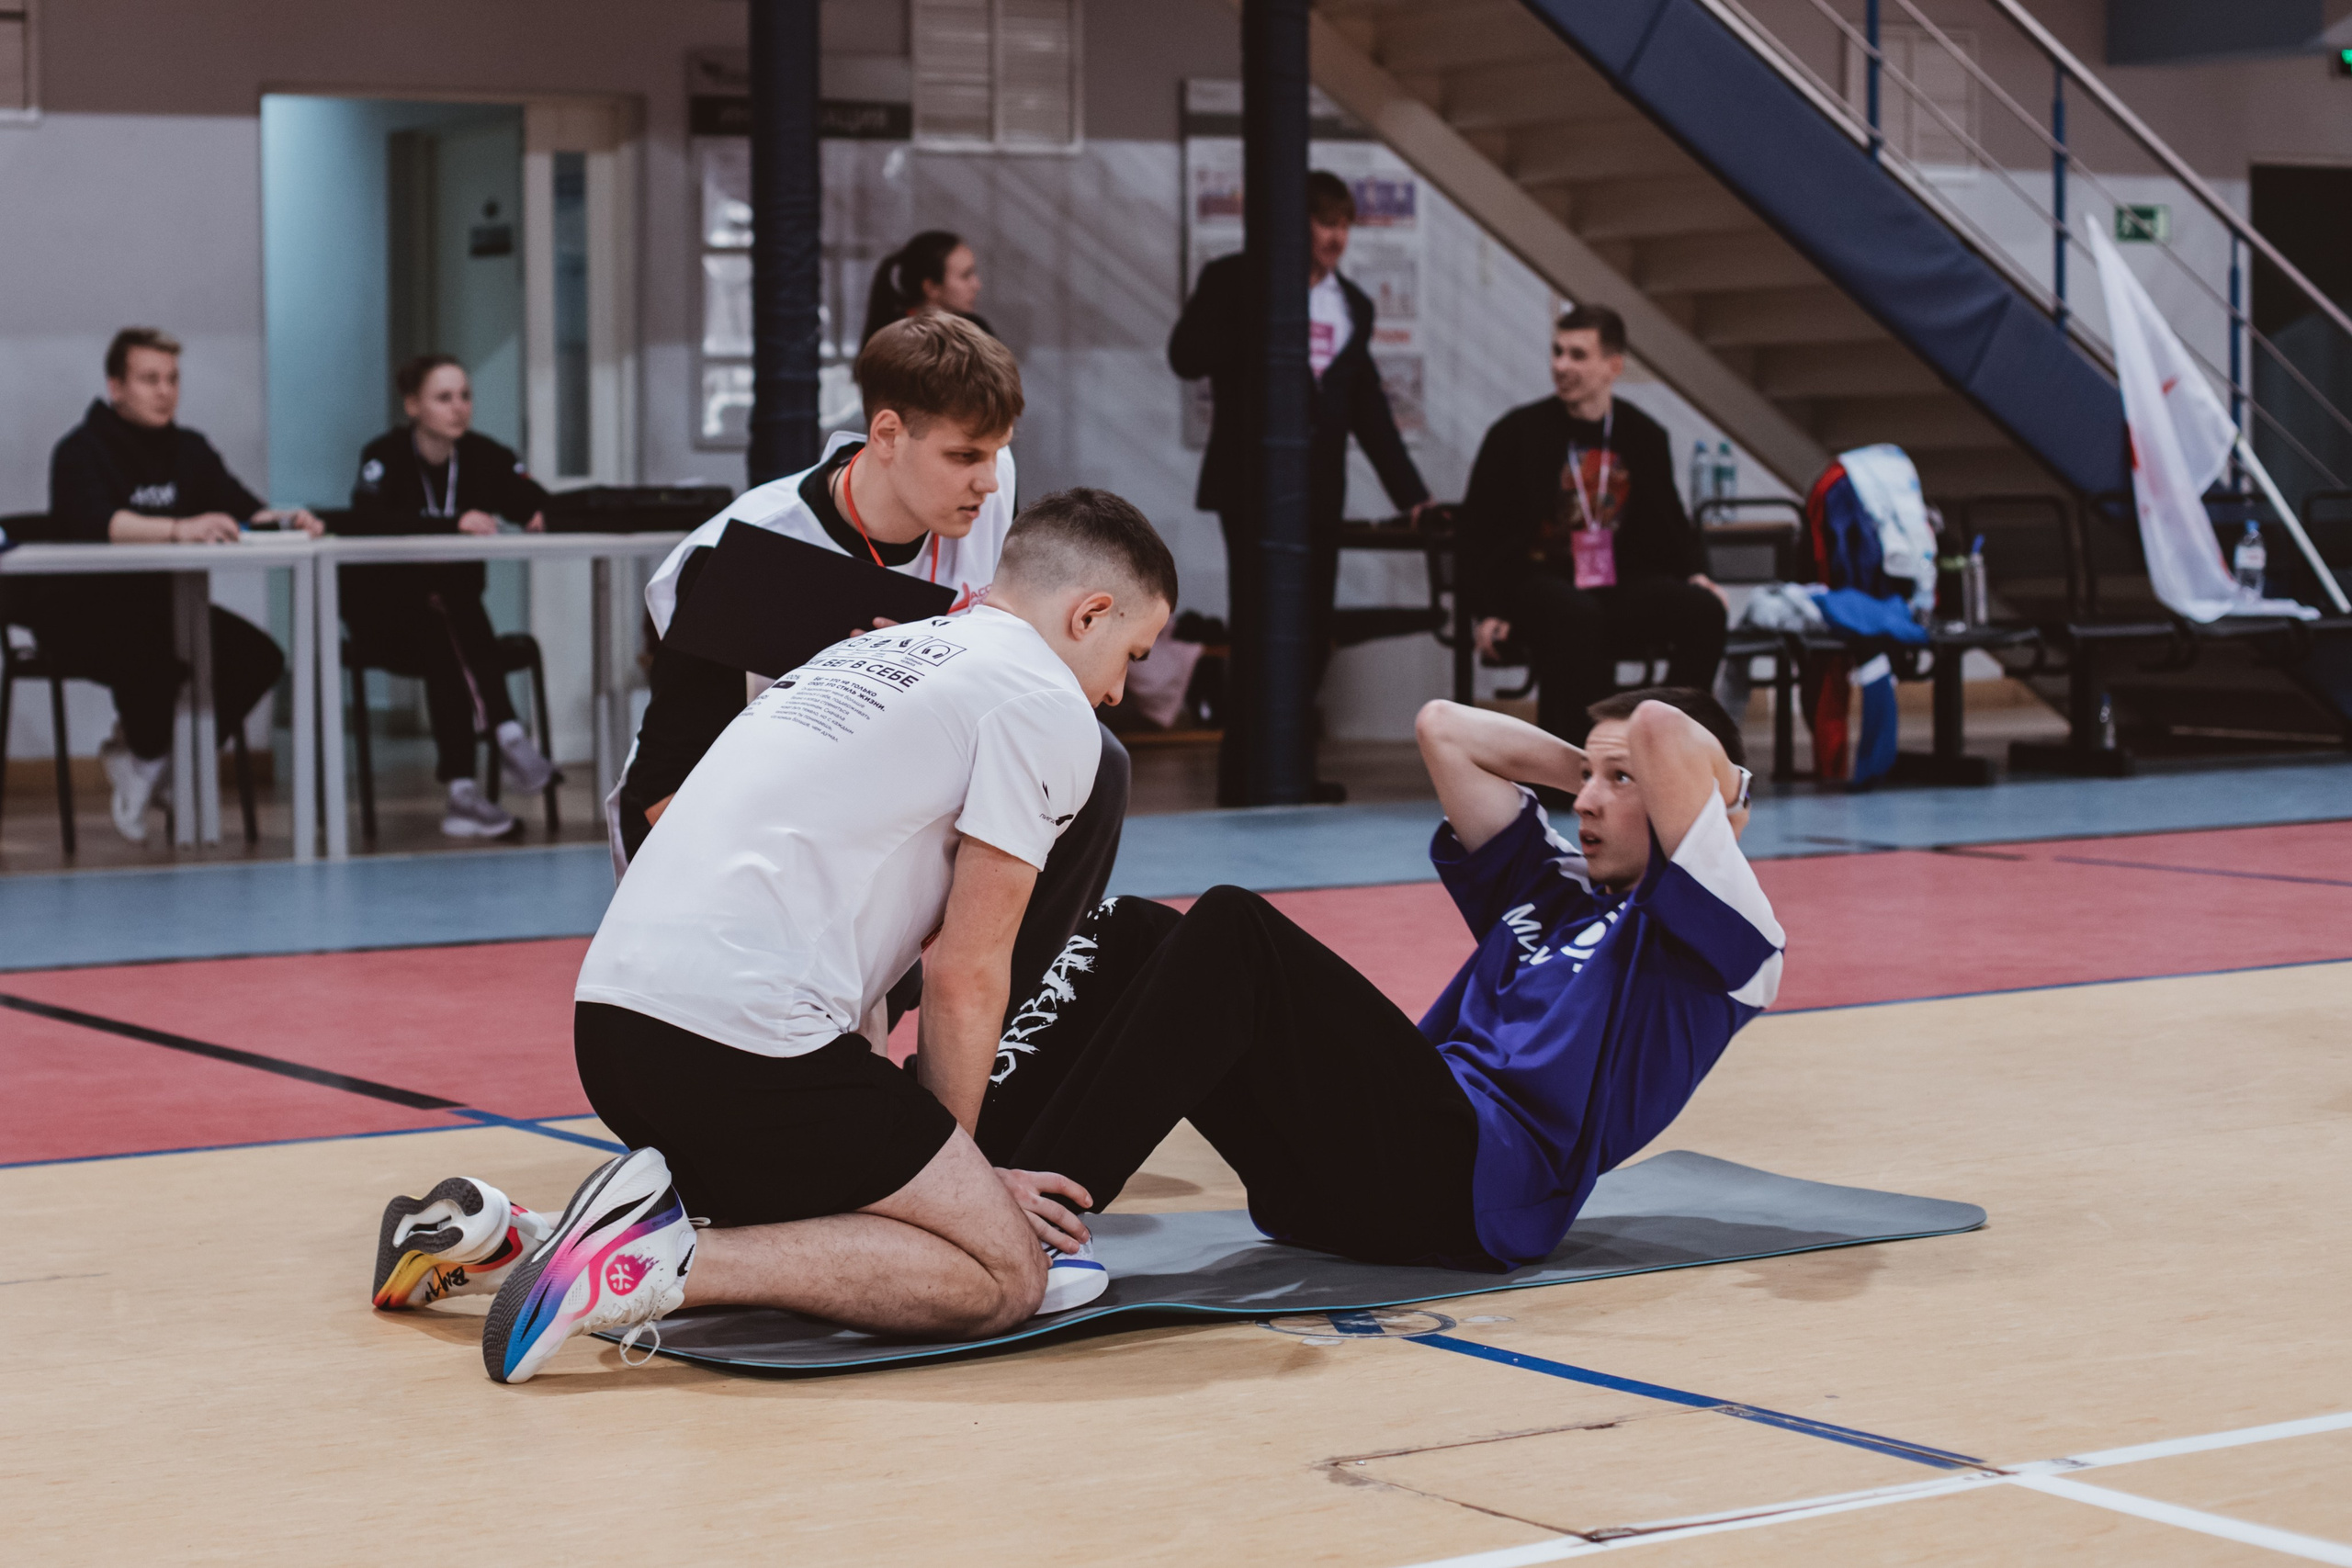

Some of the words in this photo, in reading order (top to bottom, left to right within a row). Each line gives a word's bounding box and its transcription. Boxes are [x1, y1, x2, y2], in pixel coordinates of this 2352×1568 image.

[821, 659, 854, 668] БЕГ
[850, 660, 866, 669] В
[865, 664, 920, 688] СЕБЕ
[836, 683, 857, 695] стиль
[857, 693, 886, 712] жизни.
[851, 682, 877, 697] только
[989, 934, 1099, 1085] URBAN
